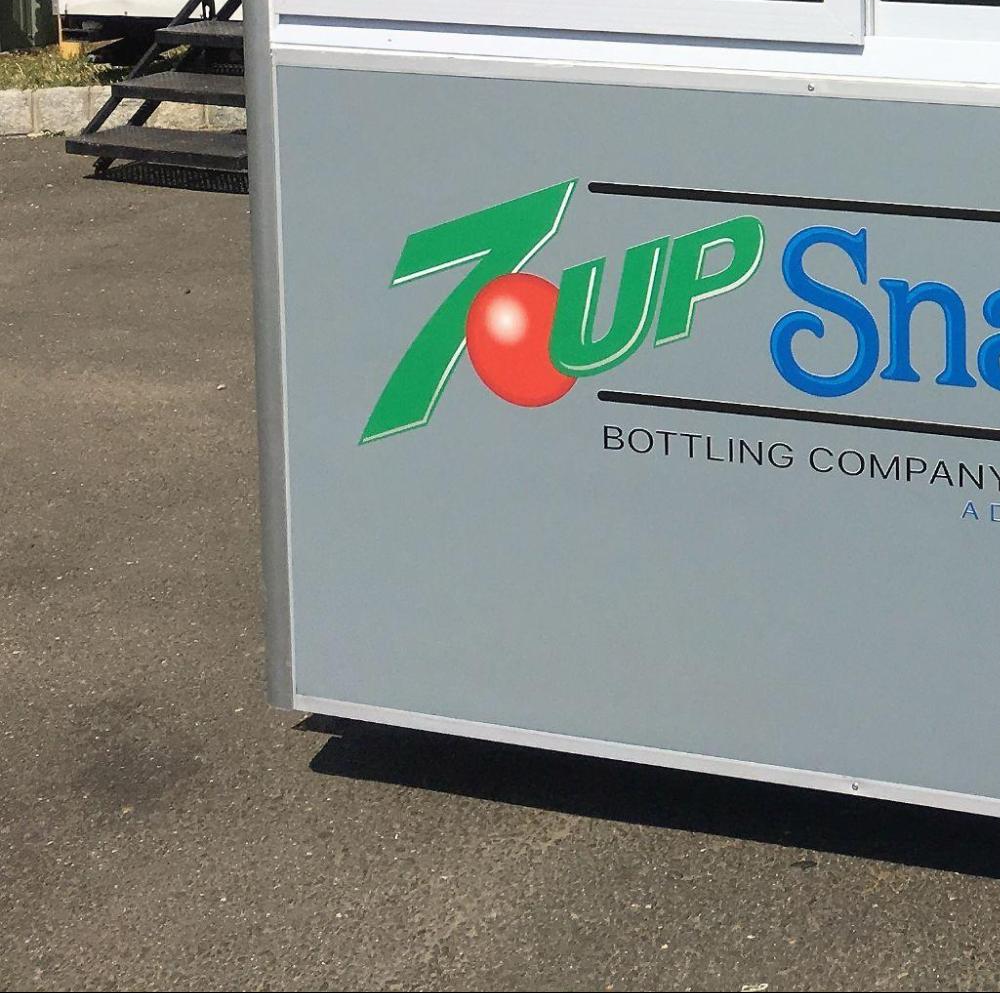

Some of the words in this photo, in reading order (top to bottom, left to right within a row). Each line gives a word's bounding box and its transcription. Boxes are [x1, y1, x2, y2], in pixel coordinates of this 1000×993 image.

[358, 177, 766, 445] 7UP
[603, 424, 795, 469] BOTTLING
[961, 501, 979, 521] A
